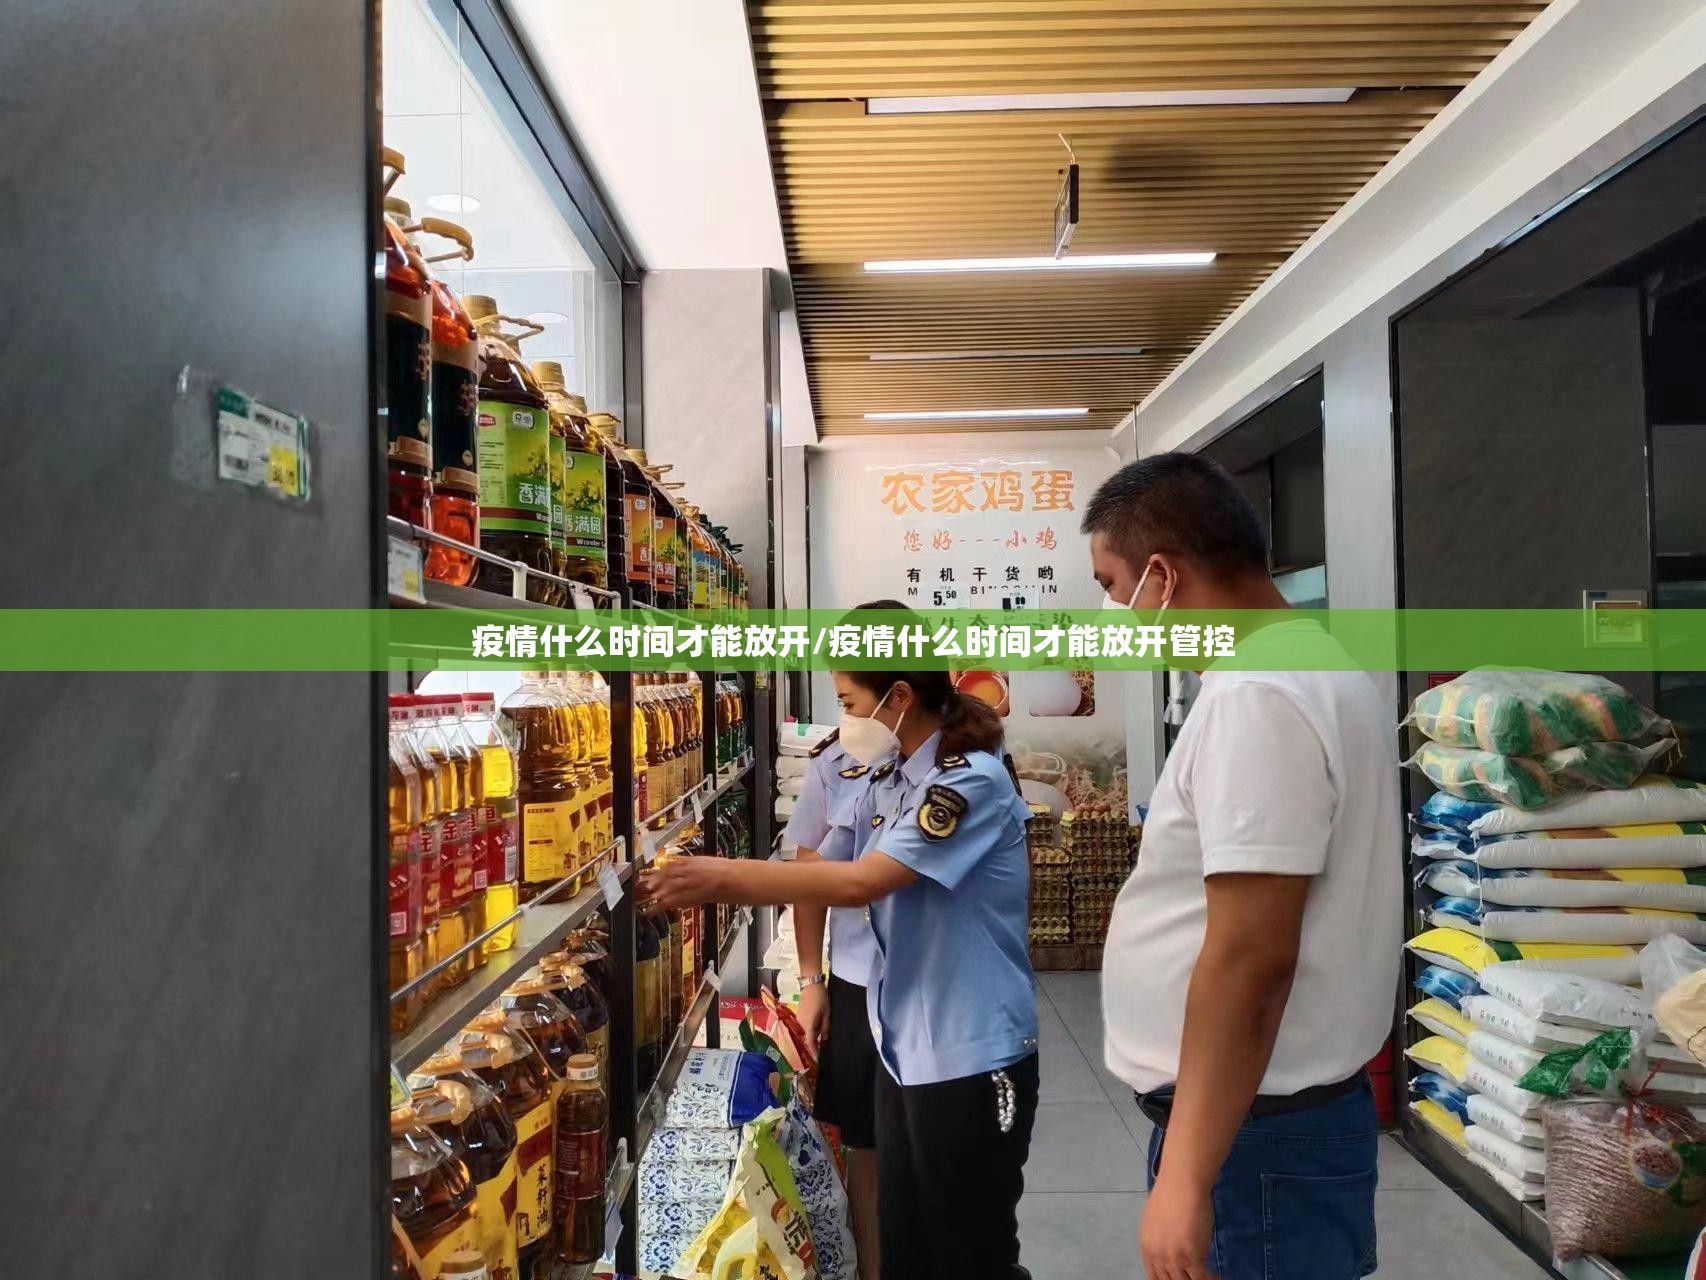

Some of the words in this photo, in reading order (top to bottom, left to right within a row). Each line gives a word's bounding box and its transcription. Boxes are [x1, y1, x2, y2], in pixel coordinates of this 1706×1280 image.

[880, 470, 1075, 515] 农家鸡蛋
[907, 566, 1053, 583] 有机干货哟
[933, 590, 957, 606] 5.50
